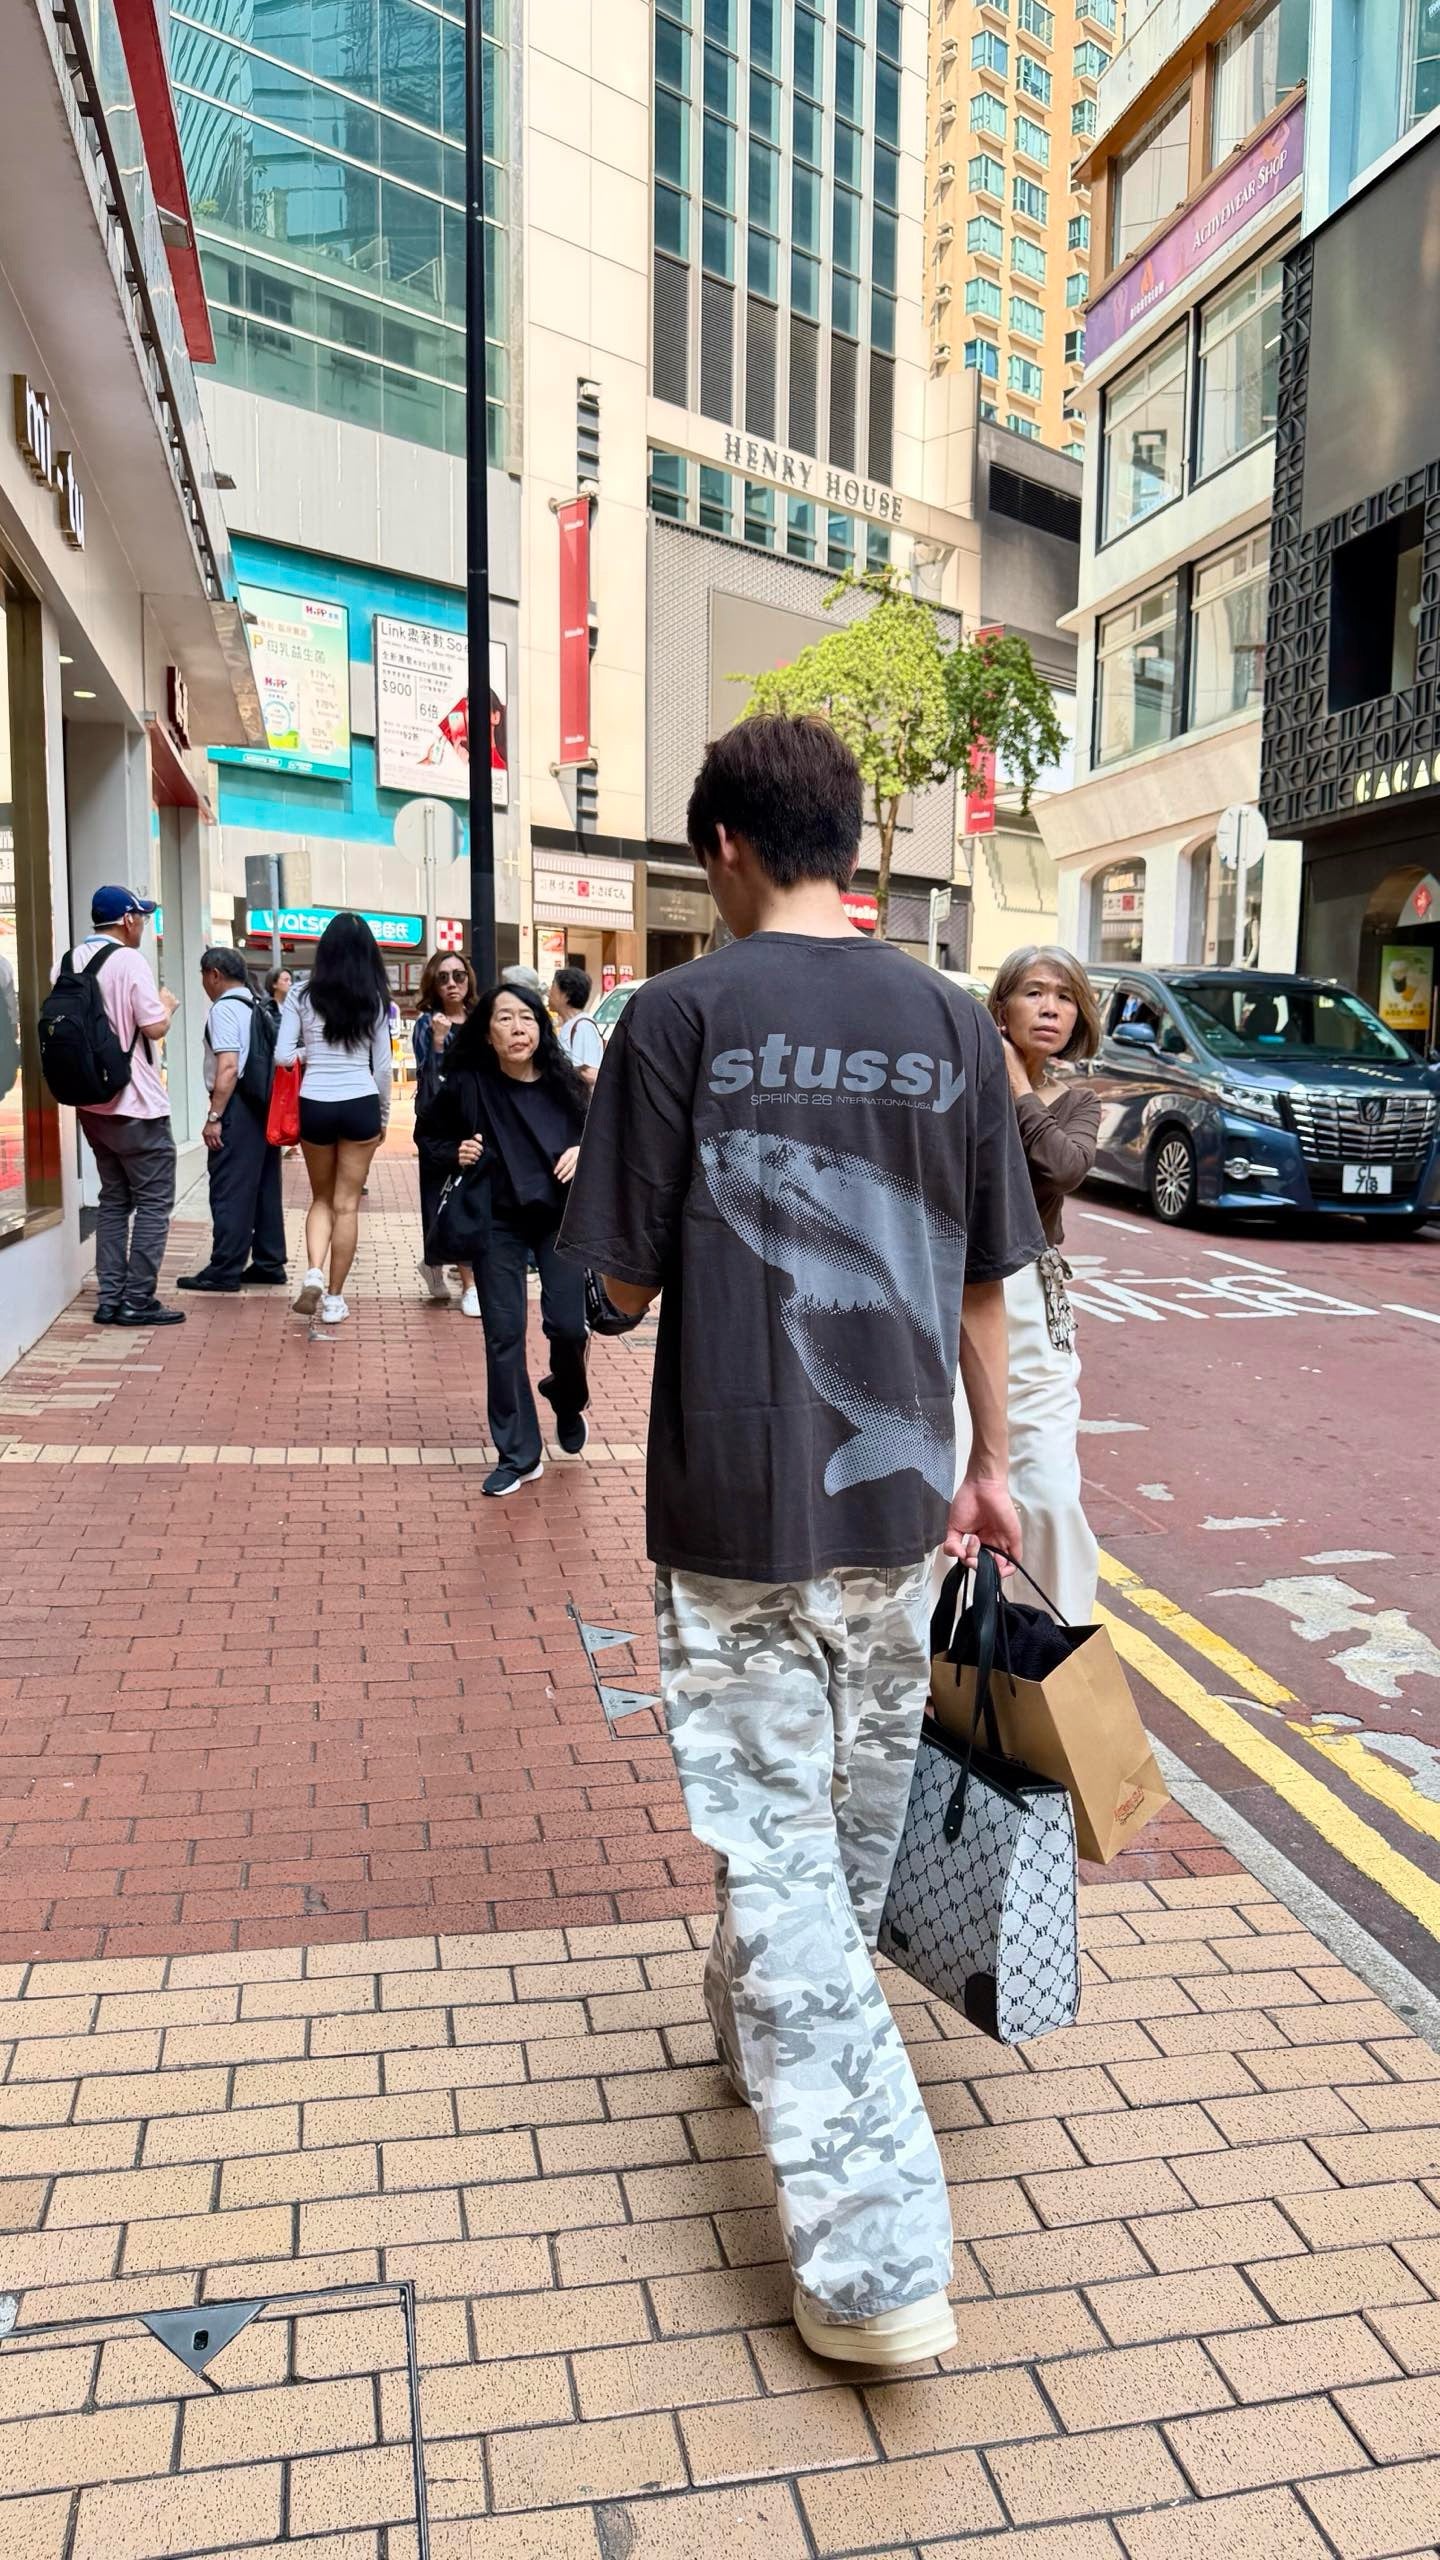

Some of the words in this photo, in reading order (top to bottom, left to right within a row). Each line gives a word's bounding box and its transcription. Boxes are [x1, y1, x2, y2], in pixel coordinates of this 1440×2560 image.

[1193, 179, 1256, 250] ACTIVEWEAR
[1257, 150, 1288, 190] SHOP
[725, 432, 813, 490] HENRY
[826, 471, 903, 523] HOUSE
[447, 637, 462, 653] So
[382, 679, 412, 697] $900
[708, 1033, 966, 1113] stussy
[750, 1093, 808, 1106] SPRING
[811, 1094, 833, 1106] 26
[835, 1095, 913, 1109] INTERNATIONAL
[1358, 1166, 1377, 1180] CL
[1355, 1179, 1378, 1194] 718
[1065, 1275, 1381, 1323] BEW
